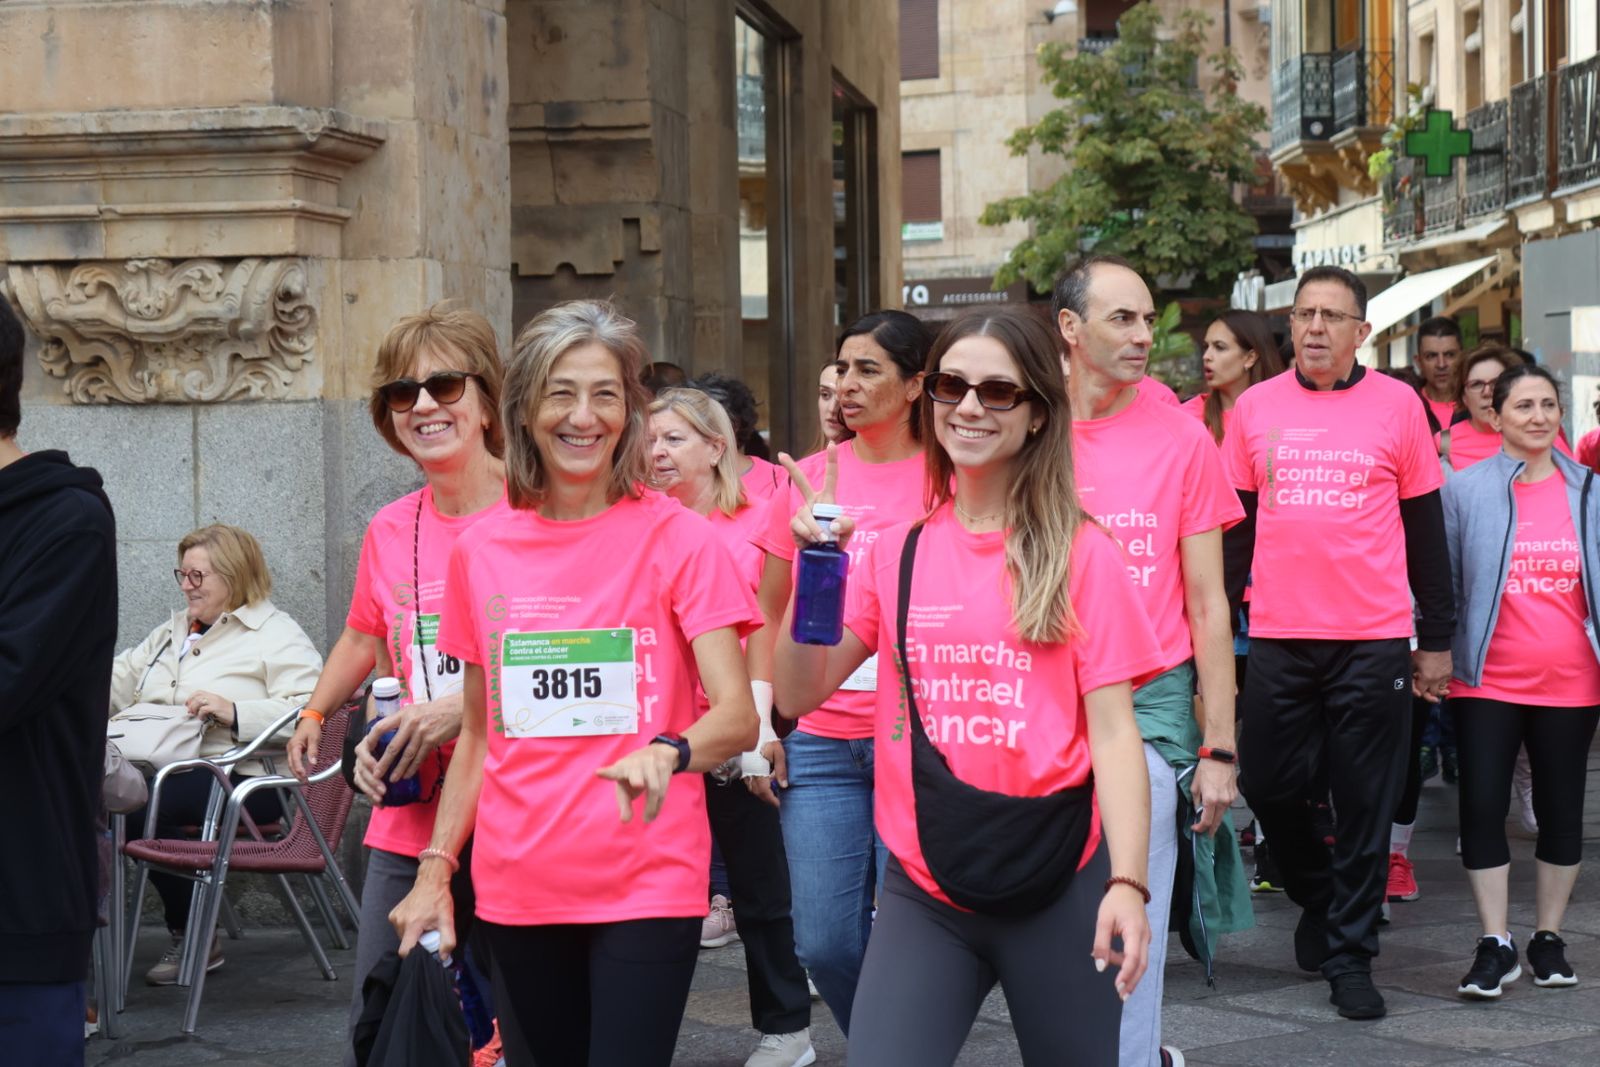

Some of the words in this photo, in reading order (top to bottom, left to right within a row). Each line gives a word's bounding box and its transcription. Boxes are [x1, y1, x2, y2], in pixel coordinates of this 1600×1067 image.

[943, 291, 1008, 304] ACCESSORIES
[1276, 446, 1299, 460] En
[1304, 448, 1375, 466] marcha
[1276, 465, 1346, 483] contra
[1350, 470, 1370, 487] el
[1276, 483, 1368, 509] cáncer
[1094, 508, 1158, 528] archa
[1128, 533, 1155, 556] el
[1509, 556, 1558, 572] ntra
[1561, 556, 1579, 572] el
[1505, 573, 1579, 594] áncer
[509, 638, 550, 647] Salamanca
[509, 646, 533, 655] contra
[535, 646, 542, 654] el
[543, 645, 568, 654] cáncer
[906, 638, 927, 663] En
[933, 641, 1032, 672] marcha
[489, 631, 504, 733] SALAMANCA
[532, 667, 602, 700] 3815
[922, 704, 1026, 748] áncer
